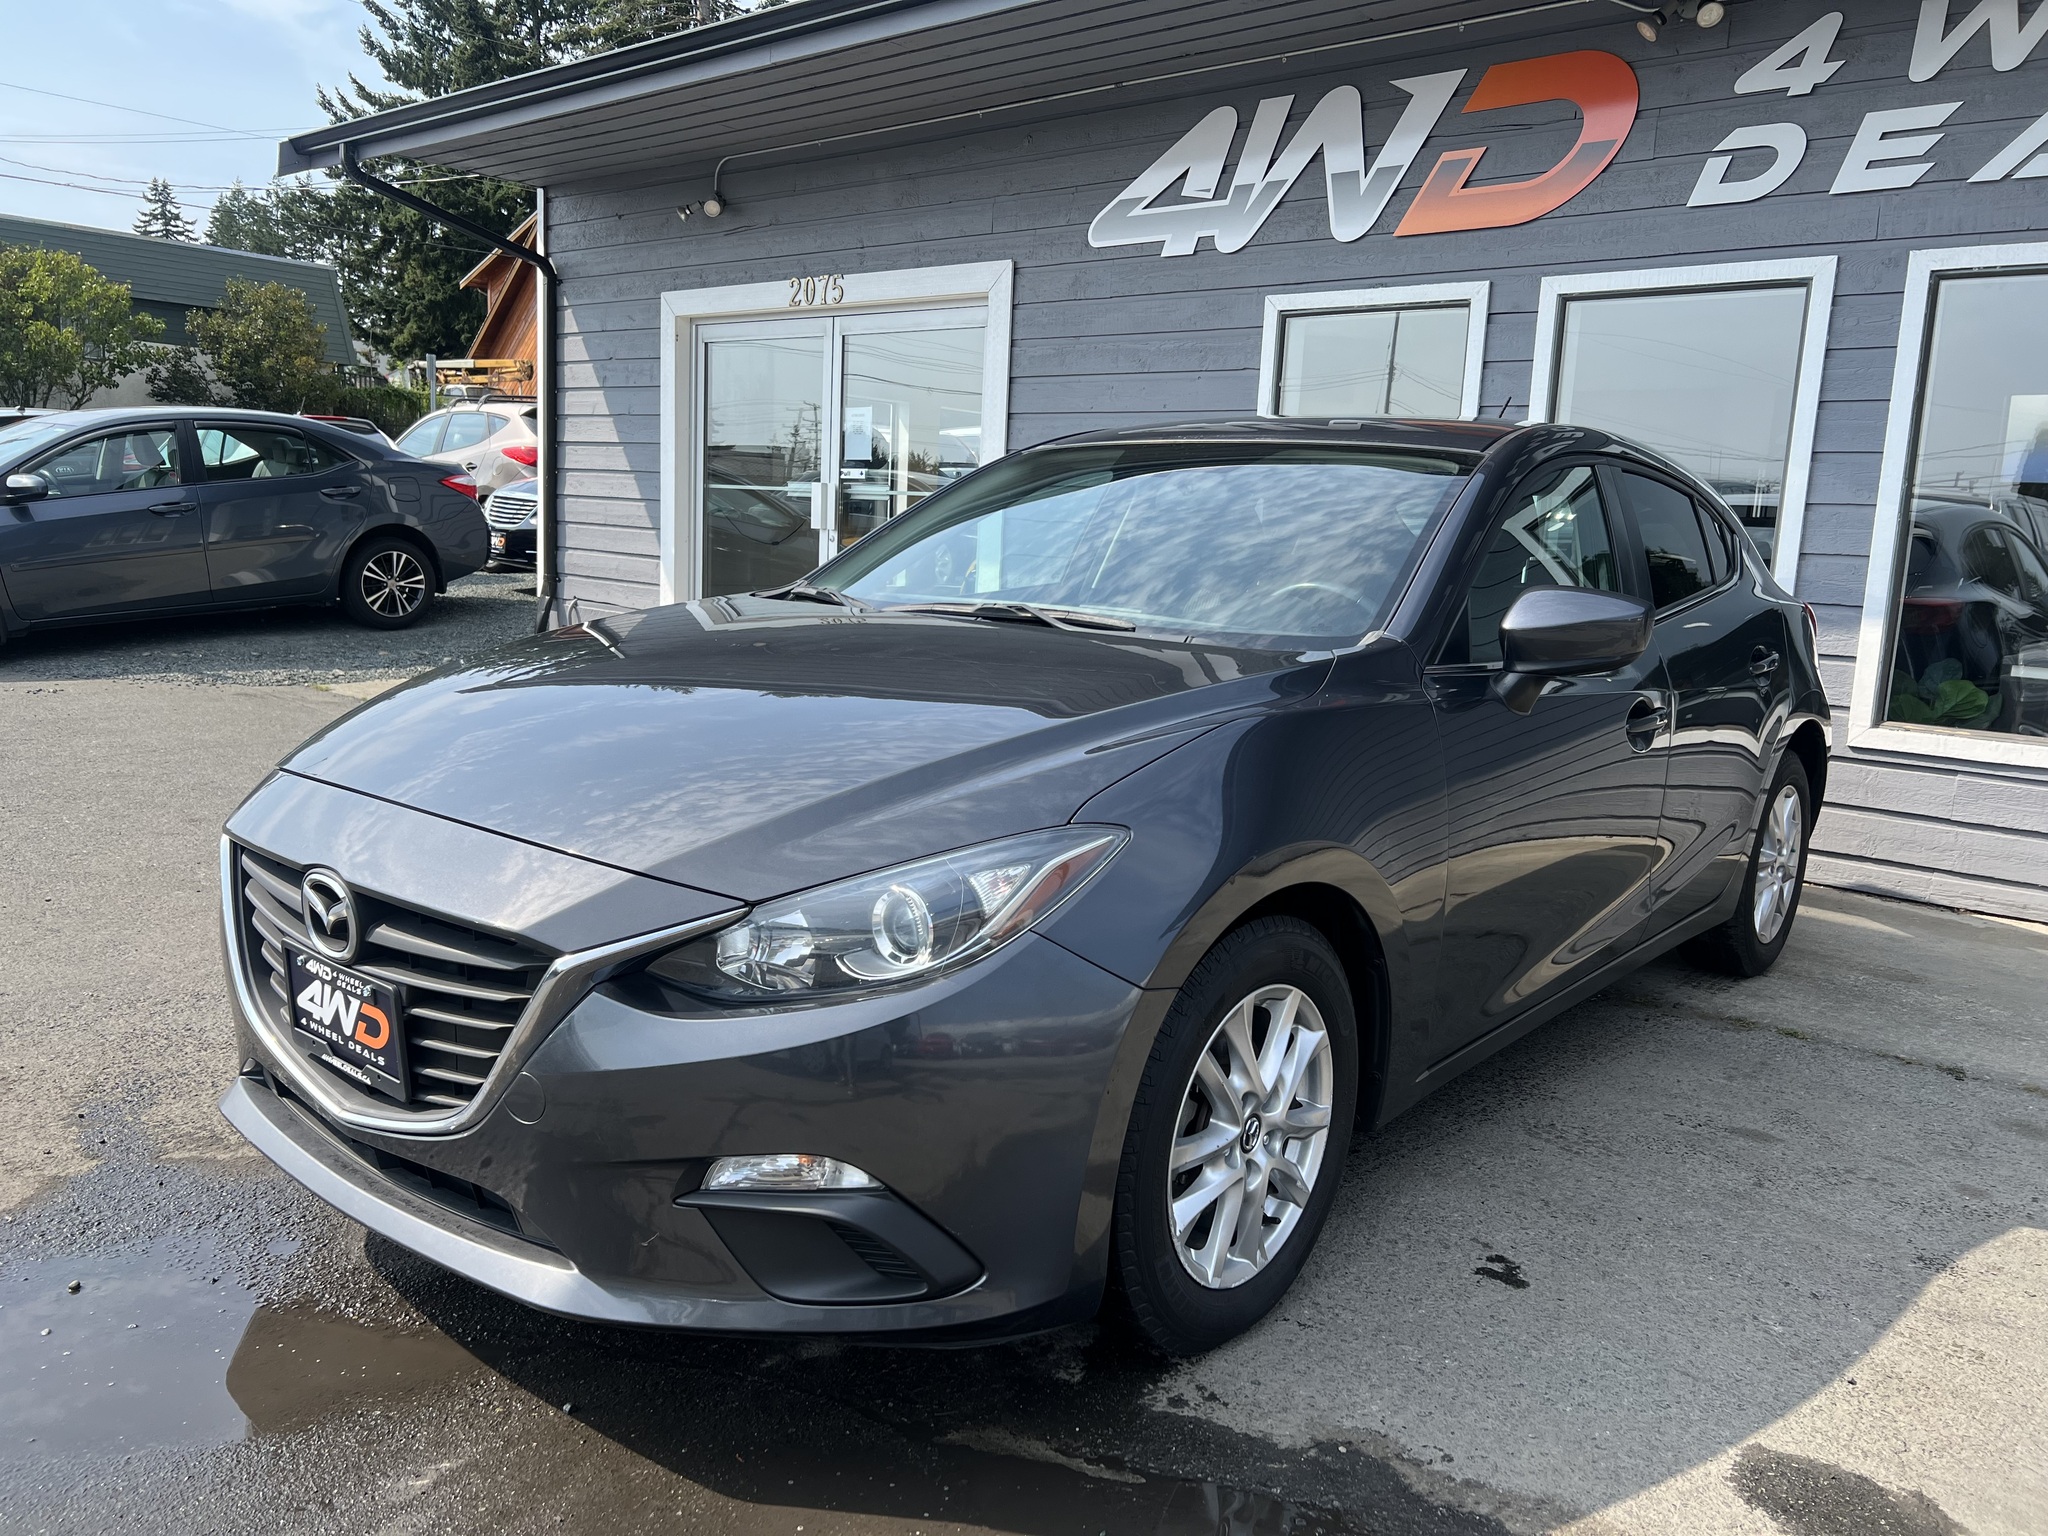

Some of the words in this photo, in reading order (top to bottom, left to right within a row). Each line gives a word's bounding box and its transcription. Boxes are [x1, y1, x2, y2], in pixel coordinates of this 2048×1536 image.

[1734, 11, 1846, 96] 4
[1088, 49, 1639, 258] 4WD
[788, 273, 844, 306] 2075
[305, 959, 332, 980] 4WD
[338, 972, 364, 988] WHEEL
[297, 979, 390, 1049] 4WD
[300, 1017, 307, 1026] 4
[309, 1020, 345, 1045] WHEEL
[348, 1040, 385, 1066] DEALS
